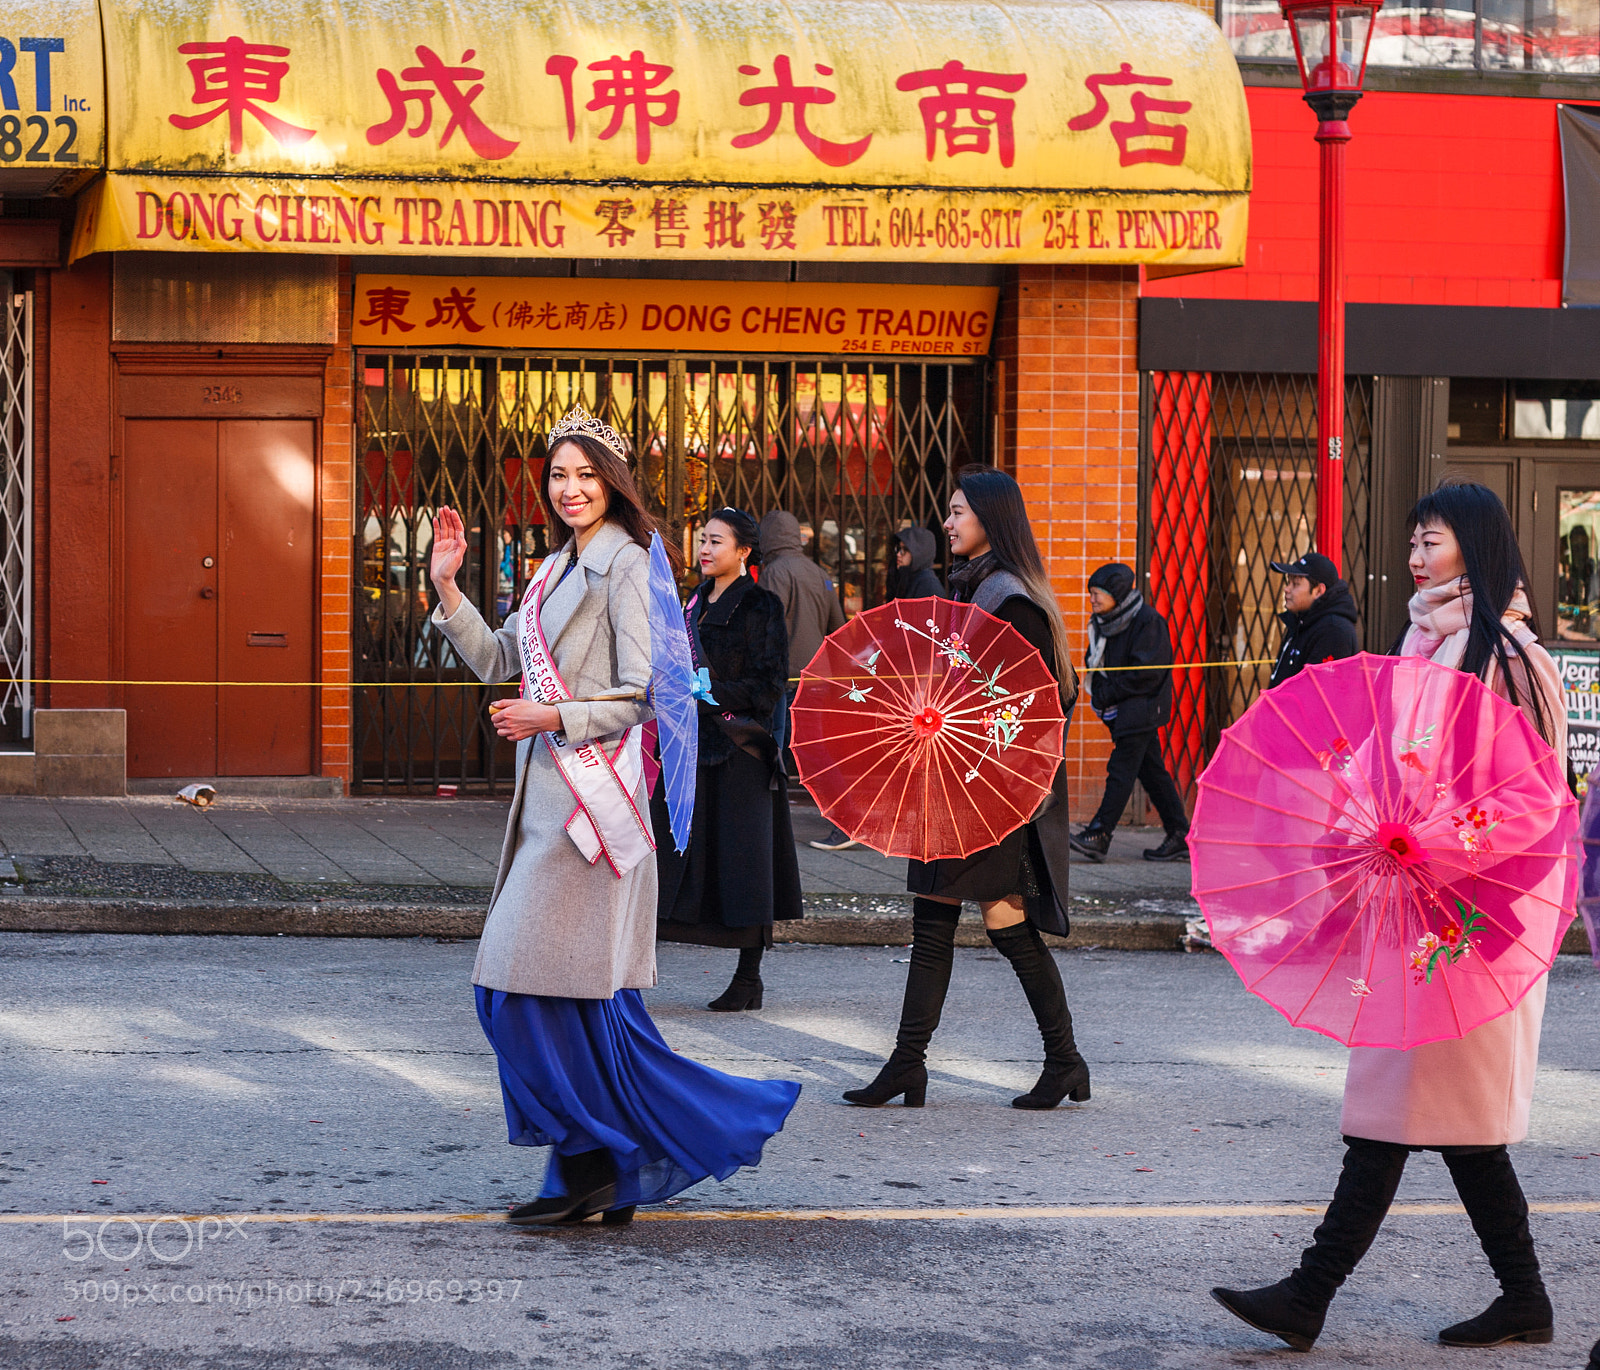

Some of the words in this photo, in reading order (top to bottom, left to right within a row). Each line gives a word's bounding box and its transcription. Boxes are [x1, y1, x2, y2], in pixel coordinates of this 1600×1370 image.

[63, 94, 92, 112] Inc.
[168, 36, 1192, 168] 東成佛光商店
[135, 191, 243, 243] DONG
[254, 193, 385, 247] CHENG
[394, 197, 566, 249] TRADING
[594, 198, 798, 250] 零售批發
[822, 205, 882, 247] TEL:
[888, 207, 1023, 249] 604-685-8717
[1043, 209, 1081, 249] 254
[1087, 209, 1110, 249] E.
[1118, 209, 1223, 250] PENDER
[359, 286, 486, 336] 東成
[641, 304, 732, 333] DONG
[742, 306, 846, 335] CHENG
[856, 308, 989, 338] TRADING
[841, 339, 867, 351] 254
[890, 340, 954, 353] PENDER
[962, 341, 984, 353] ST.
[525, 604, 539, 653] BEAUTIES
[521, 636, 533, 671] QUEEN
[528, 671, 538, 686] OF
[532, 652, 545, 668] OF
[537, 667, 549, 677] 5
[575, 744, 599, 768] 2017
